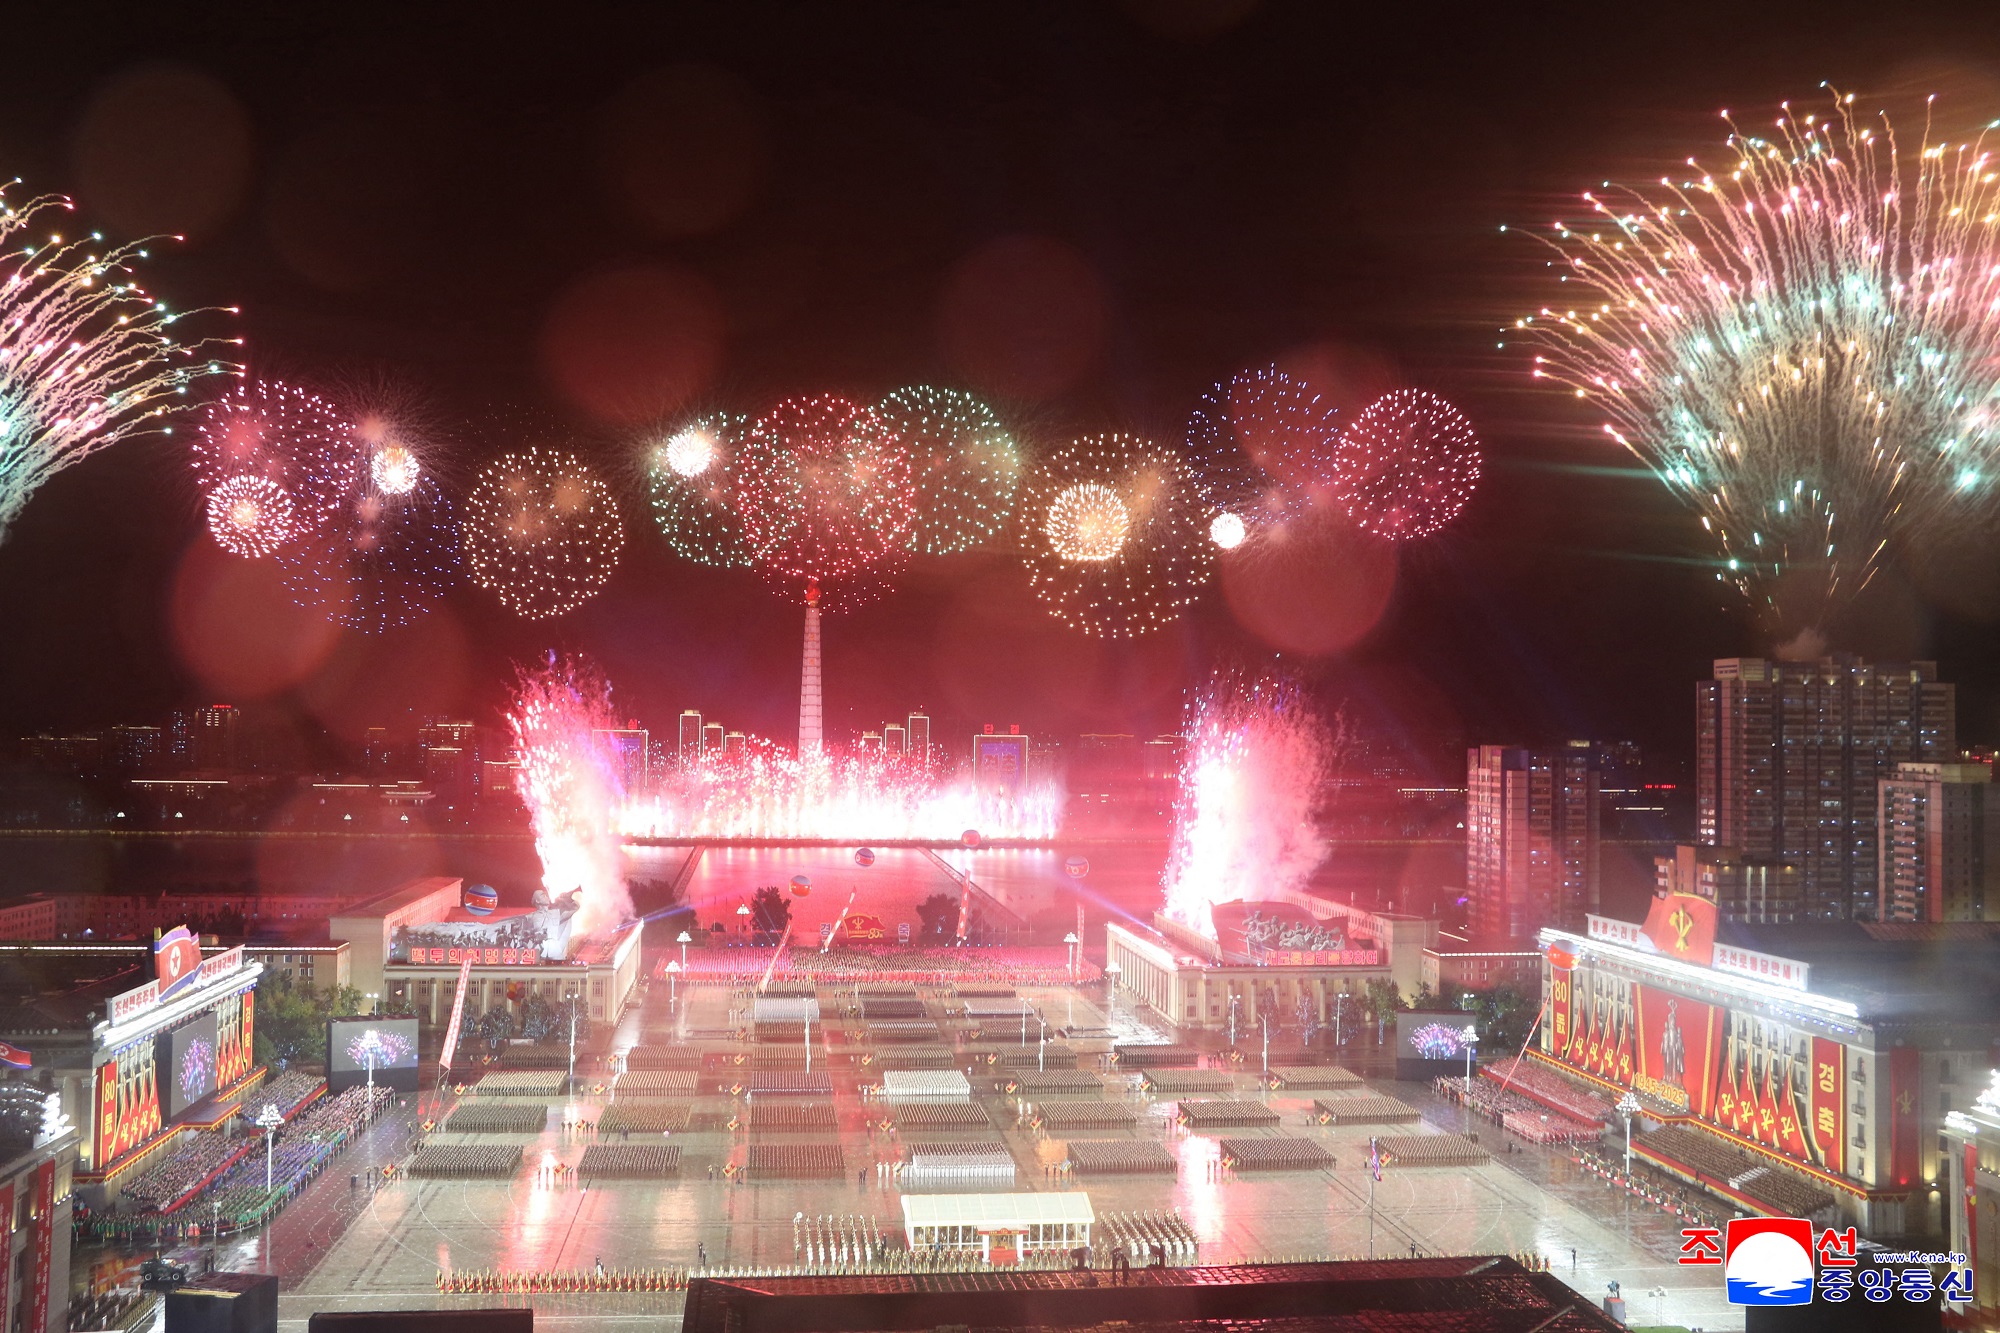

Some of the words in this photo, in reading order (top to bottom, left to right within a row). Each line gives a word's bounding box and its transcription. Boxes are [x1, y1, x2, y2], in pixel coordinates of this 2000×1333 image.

[1592, 919, 1638, 943] 영광스러운
[114, 986, 155, 1018] 조선민주주의
[1635, 1072, 1684, 1107] 1945-2025
